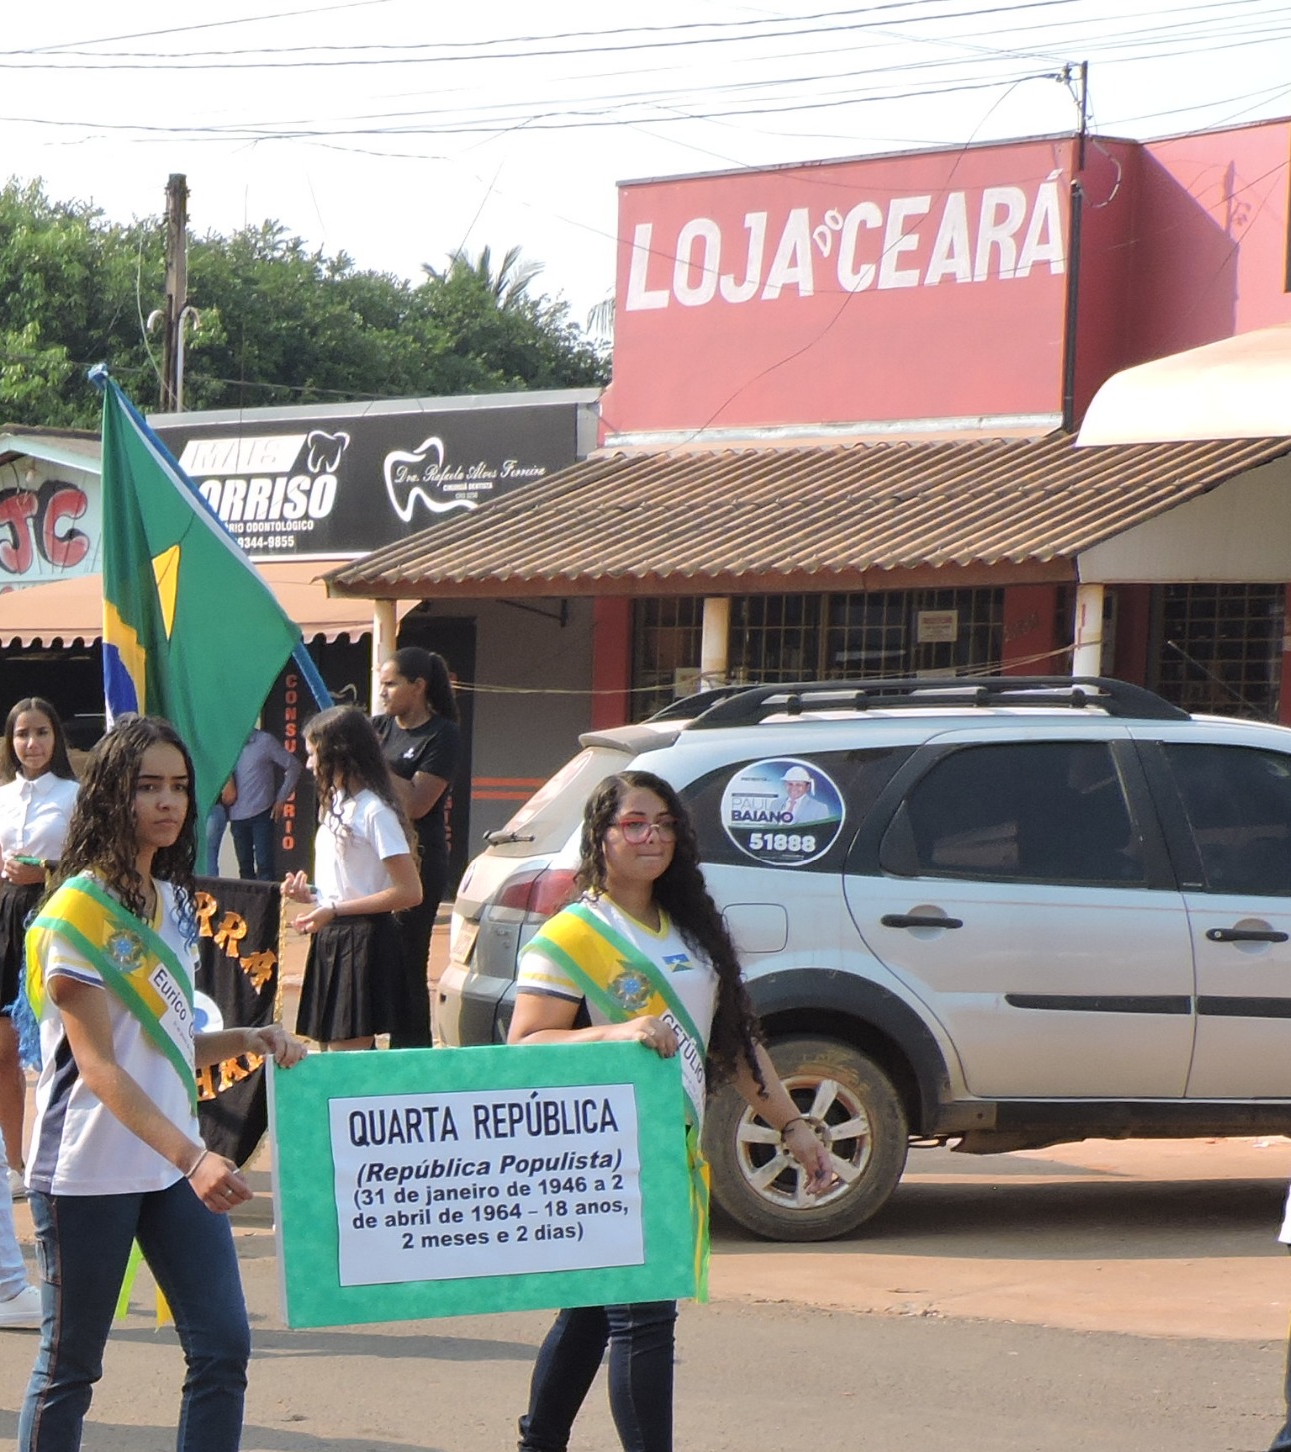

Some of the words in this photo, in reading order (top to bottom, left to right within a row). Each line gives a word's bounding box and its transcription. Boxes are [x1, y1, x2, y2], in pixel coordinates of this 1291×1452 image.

[625, 207, 814, 312] LOJA
[812, 207, 845, 258] DO
[835, 168, 1066, 294] CEARÁ
[395, 465, 420, 484] Dra.
[465, 461, 498, 481] Alves
[198, 474, 338, 521] ORRISO
[236, 535, 295, 549] 9344-9855
[245, 518, 315, 533] ODONTOLÓGICO
[731, 810, 794, 823] BAIANO
[749, 832, 816, 853] 51888
[153, 968, 187, 1021] Eurico
[349, 1105, 459, 1148] QUARTA
[474, 1090, 619, 1140] REPÚBLICA
[357, 1159, 491, 1188] (República
[500, 1148, 623, 1178] Populista)
[353, 1186, 386, 1210] (31
[394, 1186, 419, 1205] de
[425, 1181, 501, 1207] janeiro
[506, 1178, 532, 1198] de
[538, 1175, 588, 1197] 1946
[594, 1178, 607, 1192] a
[611, 1174, 625, 1191] 2
[352, 1211, 378, 1230] de
[384, 1206, 432, 1229] abril
[438, 1205, 465, 1225] de
[471, 1203, 523, 1223] 1964
[544, 1201, 569, 1219] 18
[575, 1196, 629, 1217] anos,
[401, 1232, 415, 1250] 2
[421, 1230, 490, 1249] meses
[496, 1229, 510, 1244] e
[515, 1225, 528, 1243] 2
[534, 1221, 584, 1244] dias)
